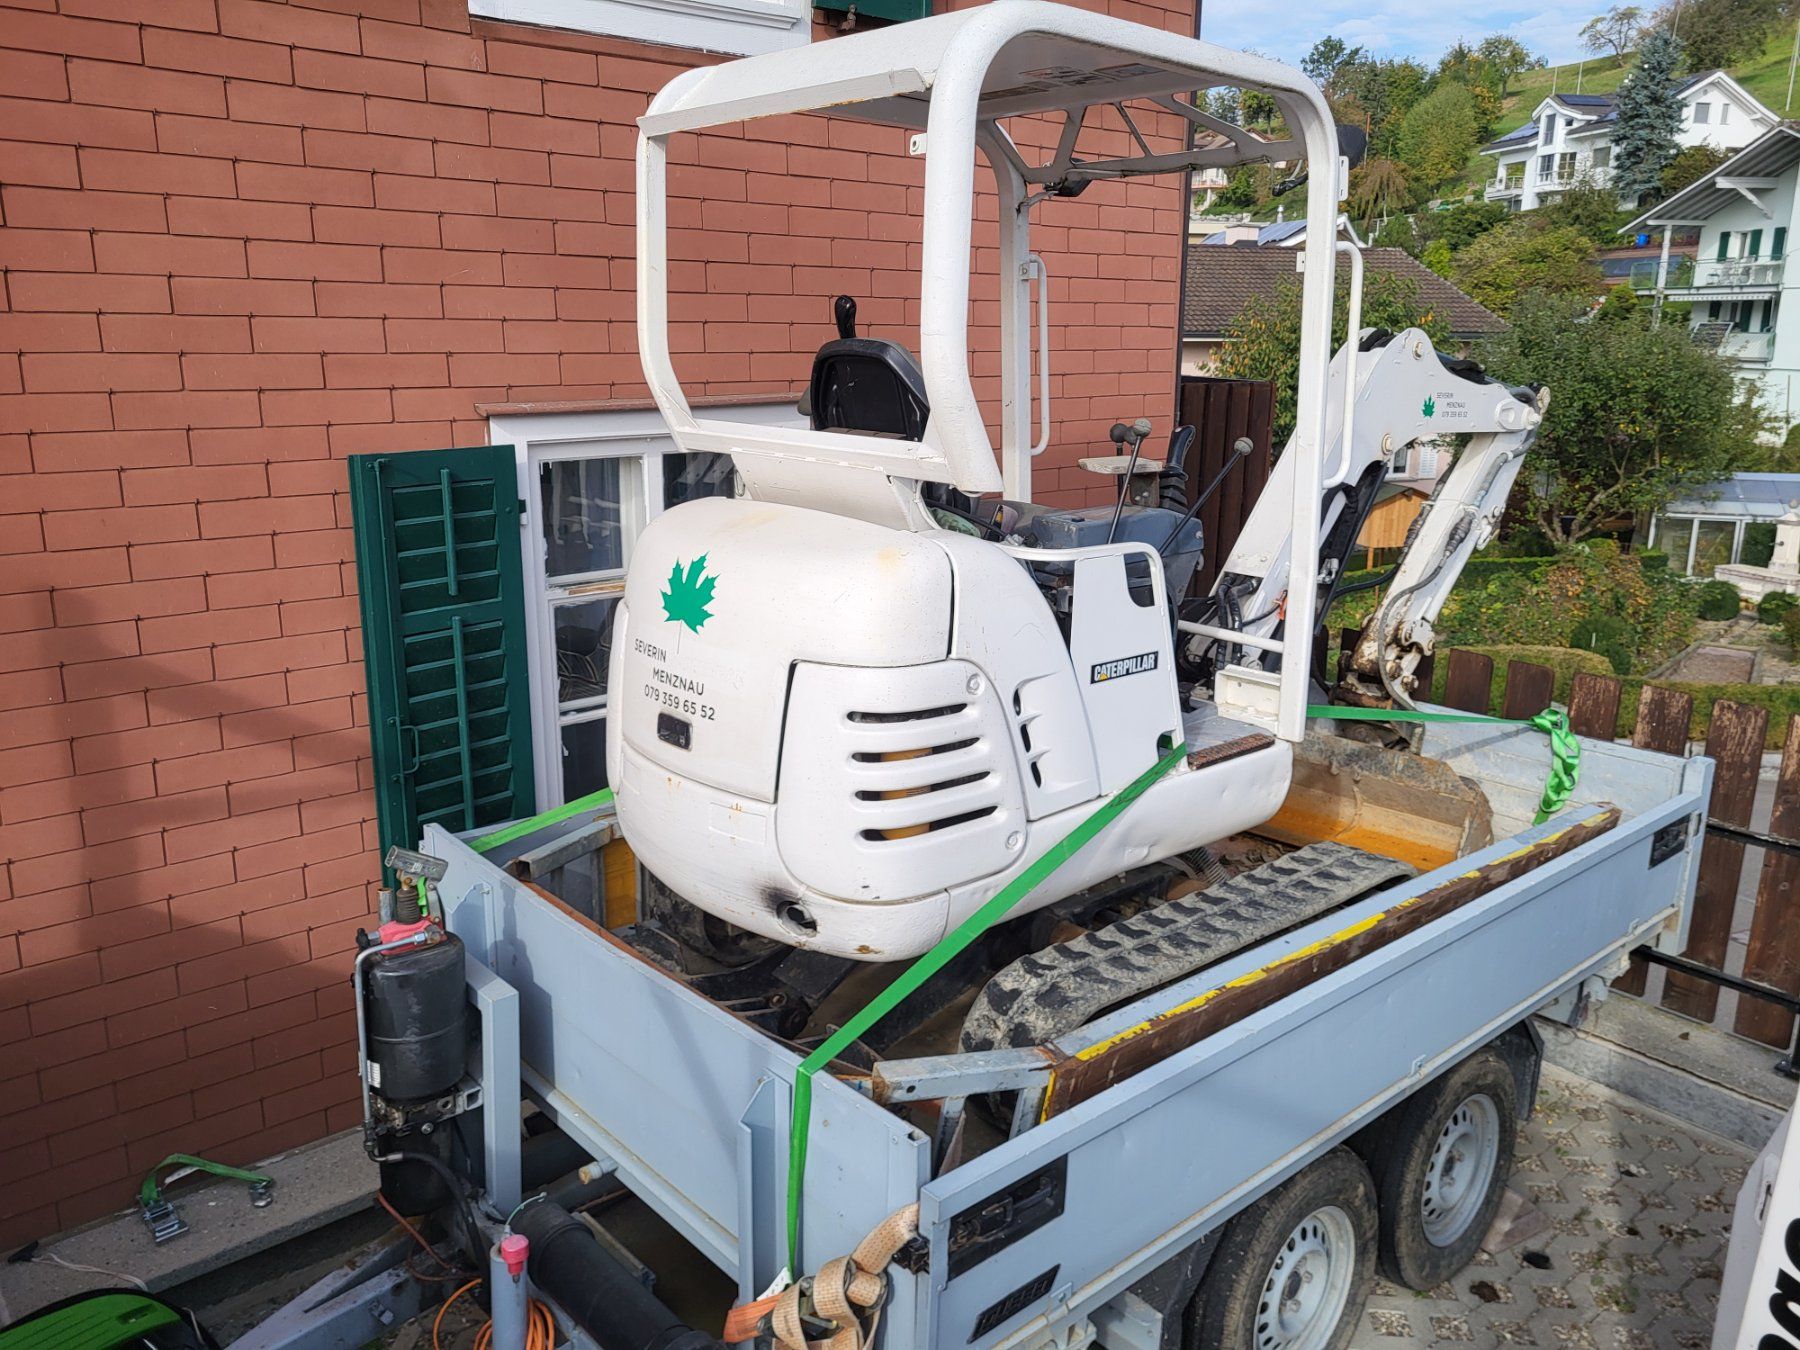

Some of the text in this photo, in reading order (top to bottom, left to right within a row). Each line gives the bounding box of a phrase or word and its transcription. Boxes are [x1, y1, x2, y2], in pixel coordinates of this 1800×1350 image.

[634, 638, 667, 663] SEVERIN
[652, 667, 705, 696] MENZNAU
[1093, 653, 1156, 682] CATERPILLAR
[644, 684, 715, 721] 079 359 65 52
